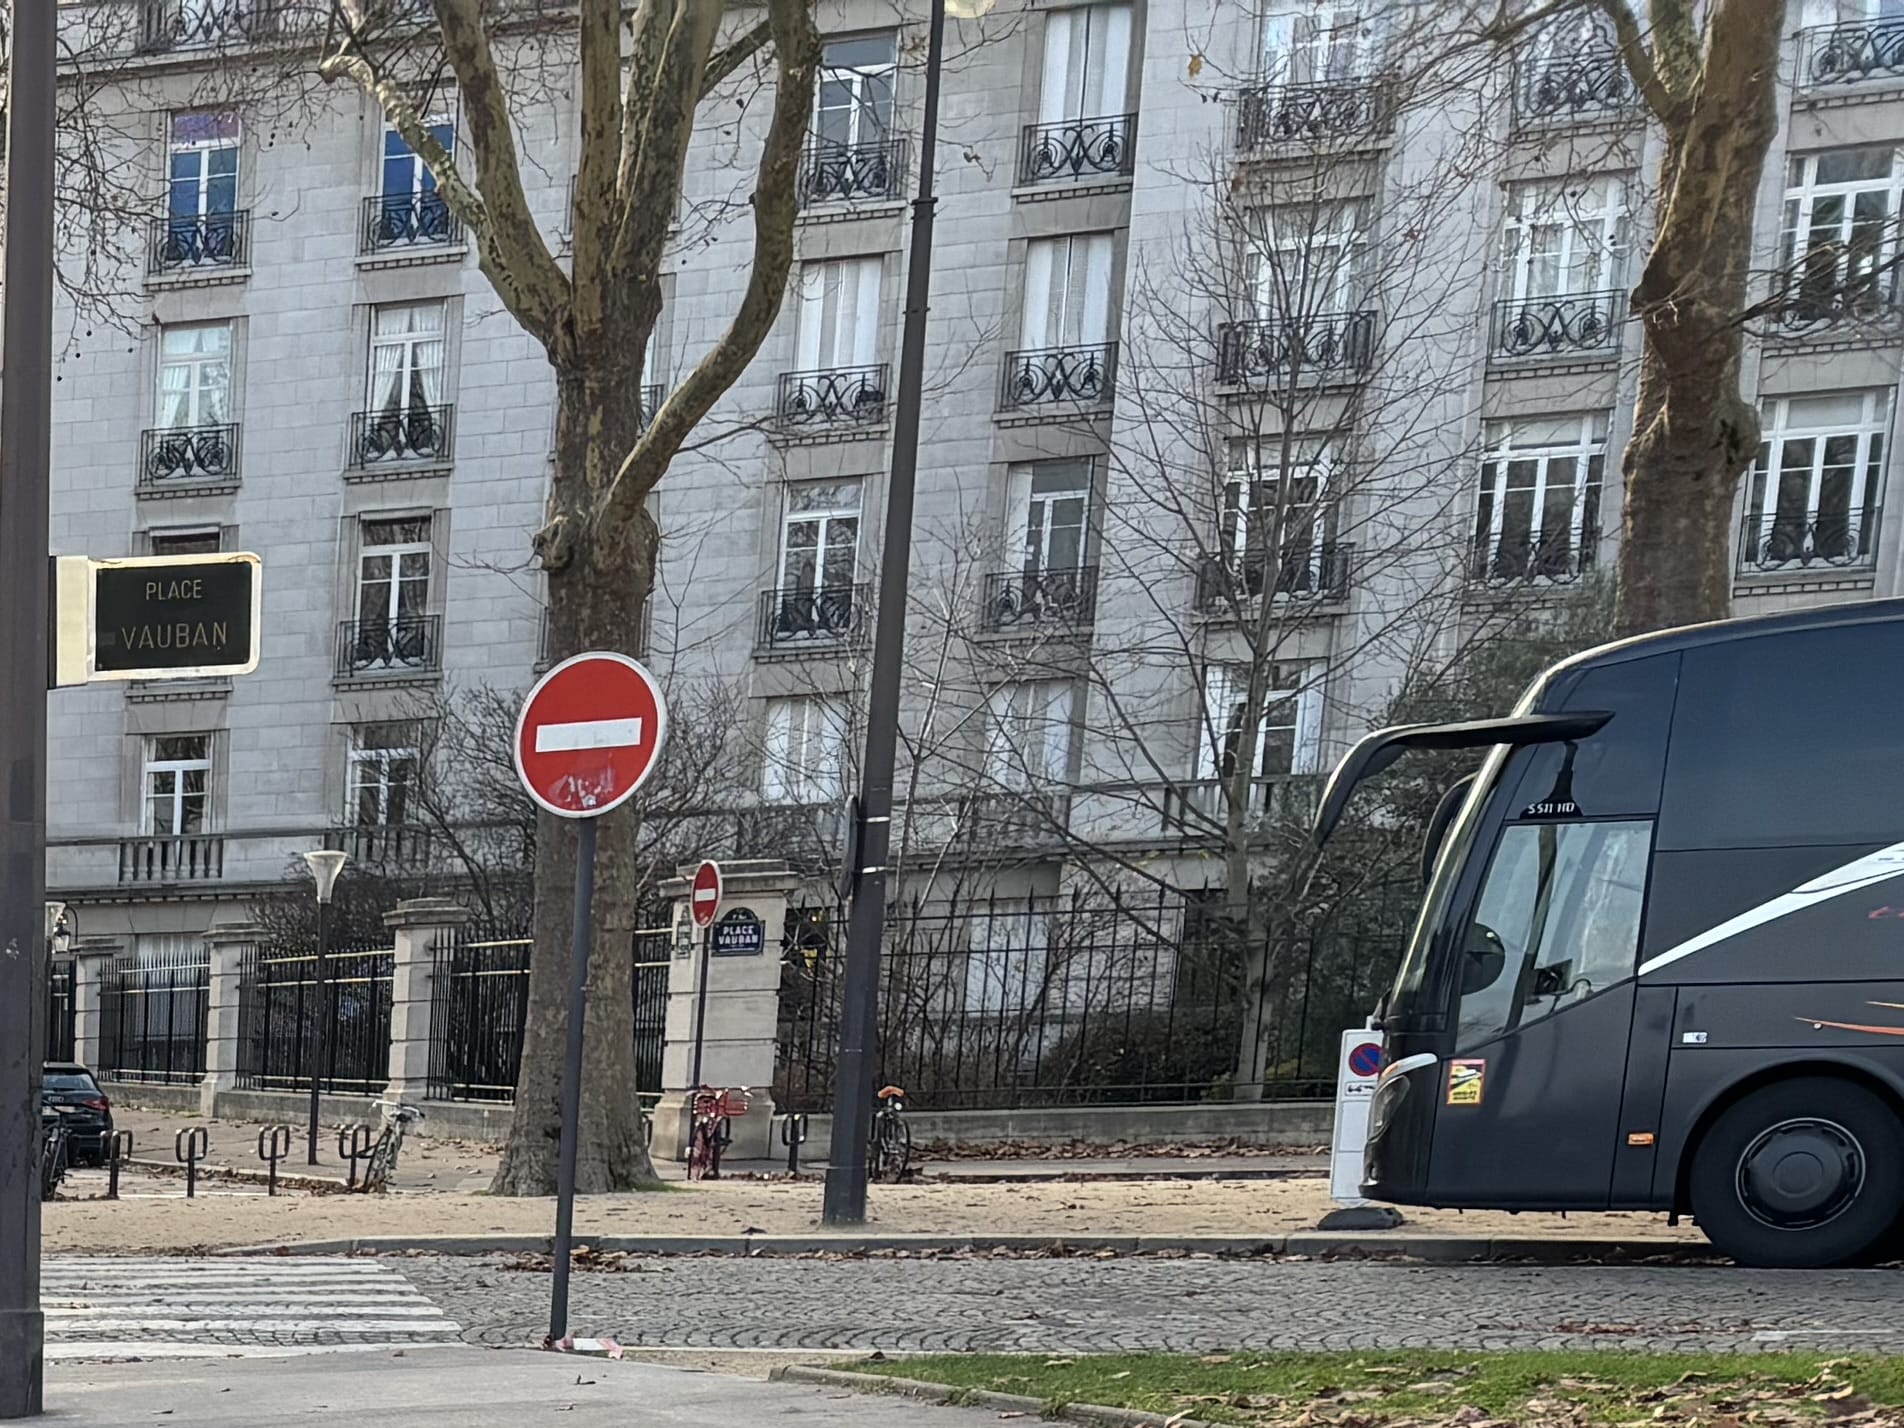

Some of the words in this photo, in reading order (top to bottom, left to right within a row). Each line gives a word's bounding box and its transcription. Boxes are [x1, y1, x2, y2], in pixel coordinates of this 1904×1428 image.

[146, 579, 203, 600] PLACE
[121, 621, 227, 650] VAUBAN
[723, 925, 754, 935] PLACE
[718, 934, 758, 945] VAUBAN
